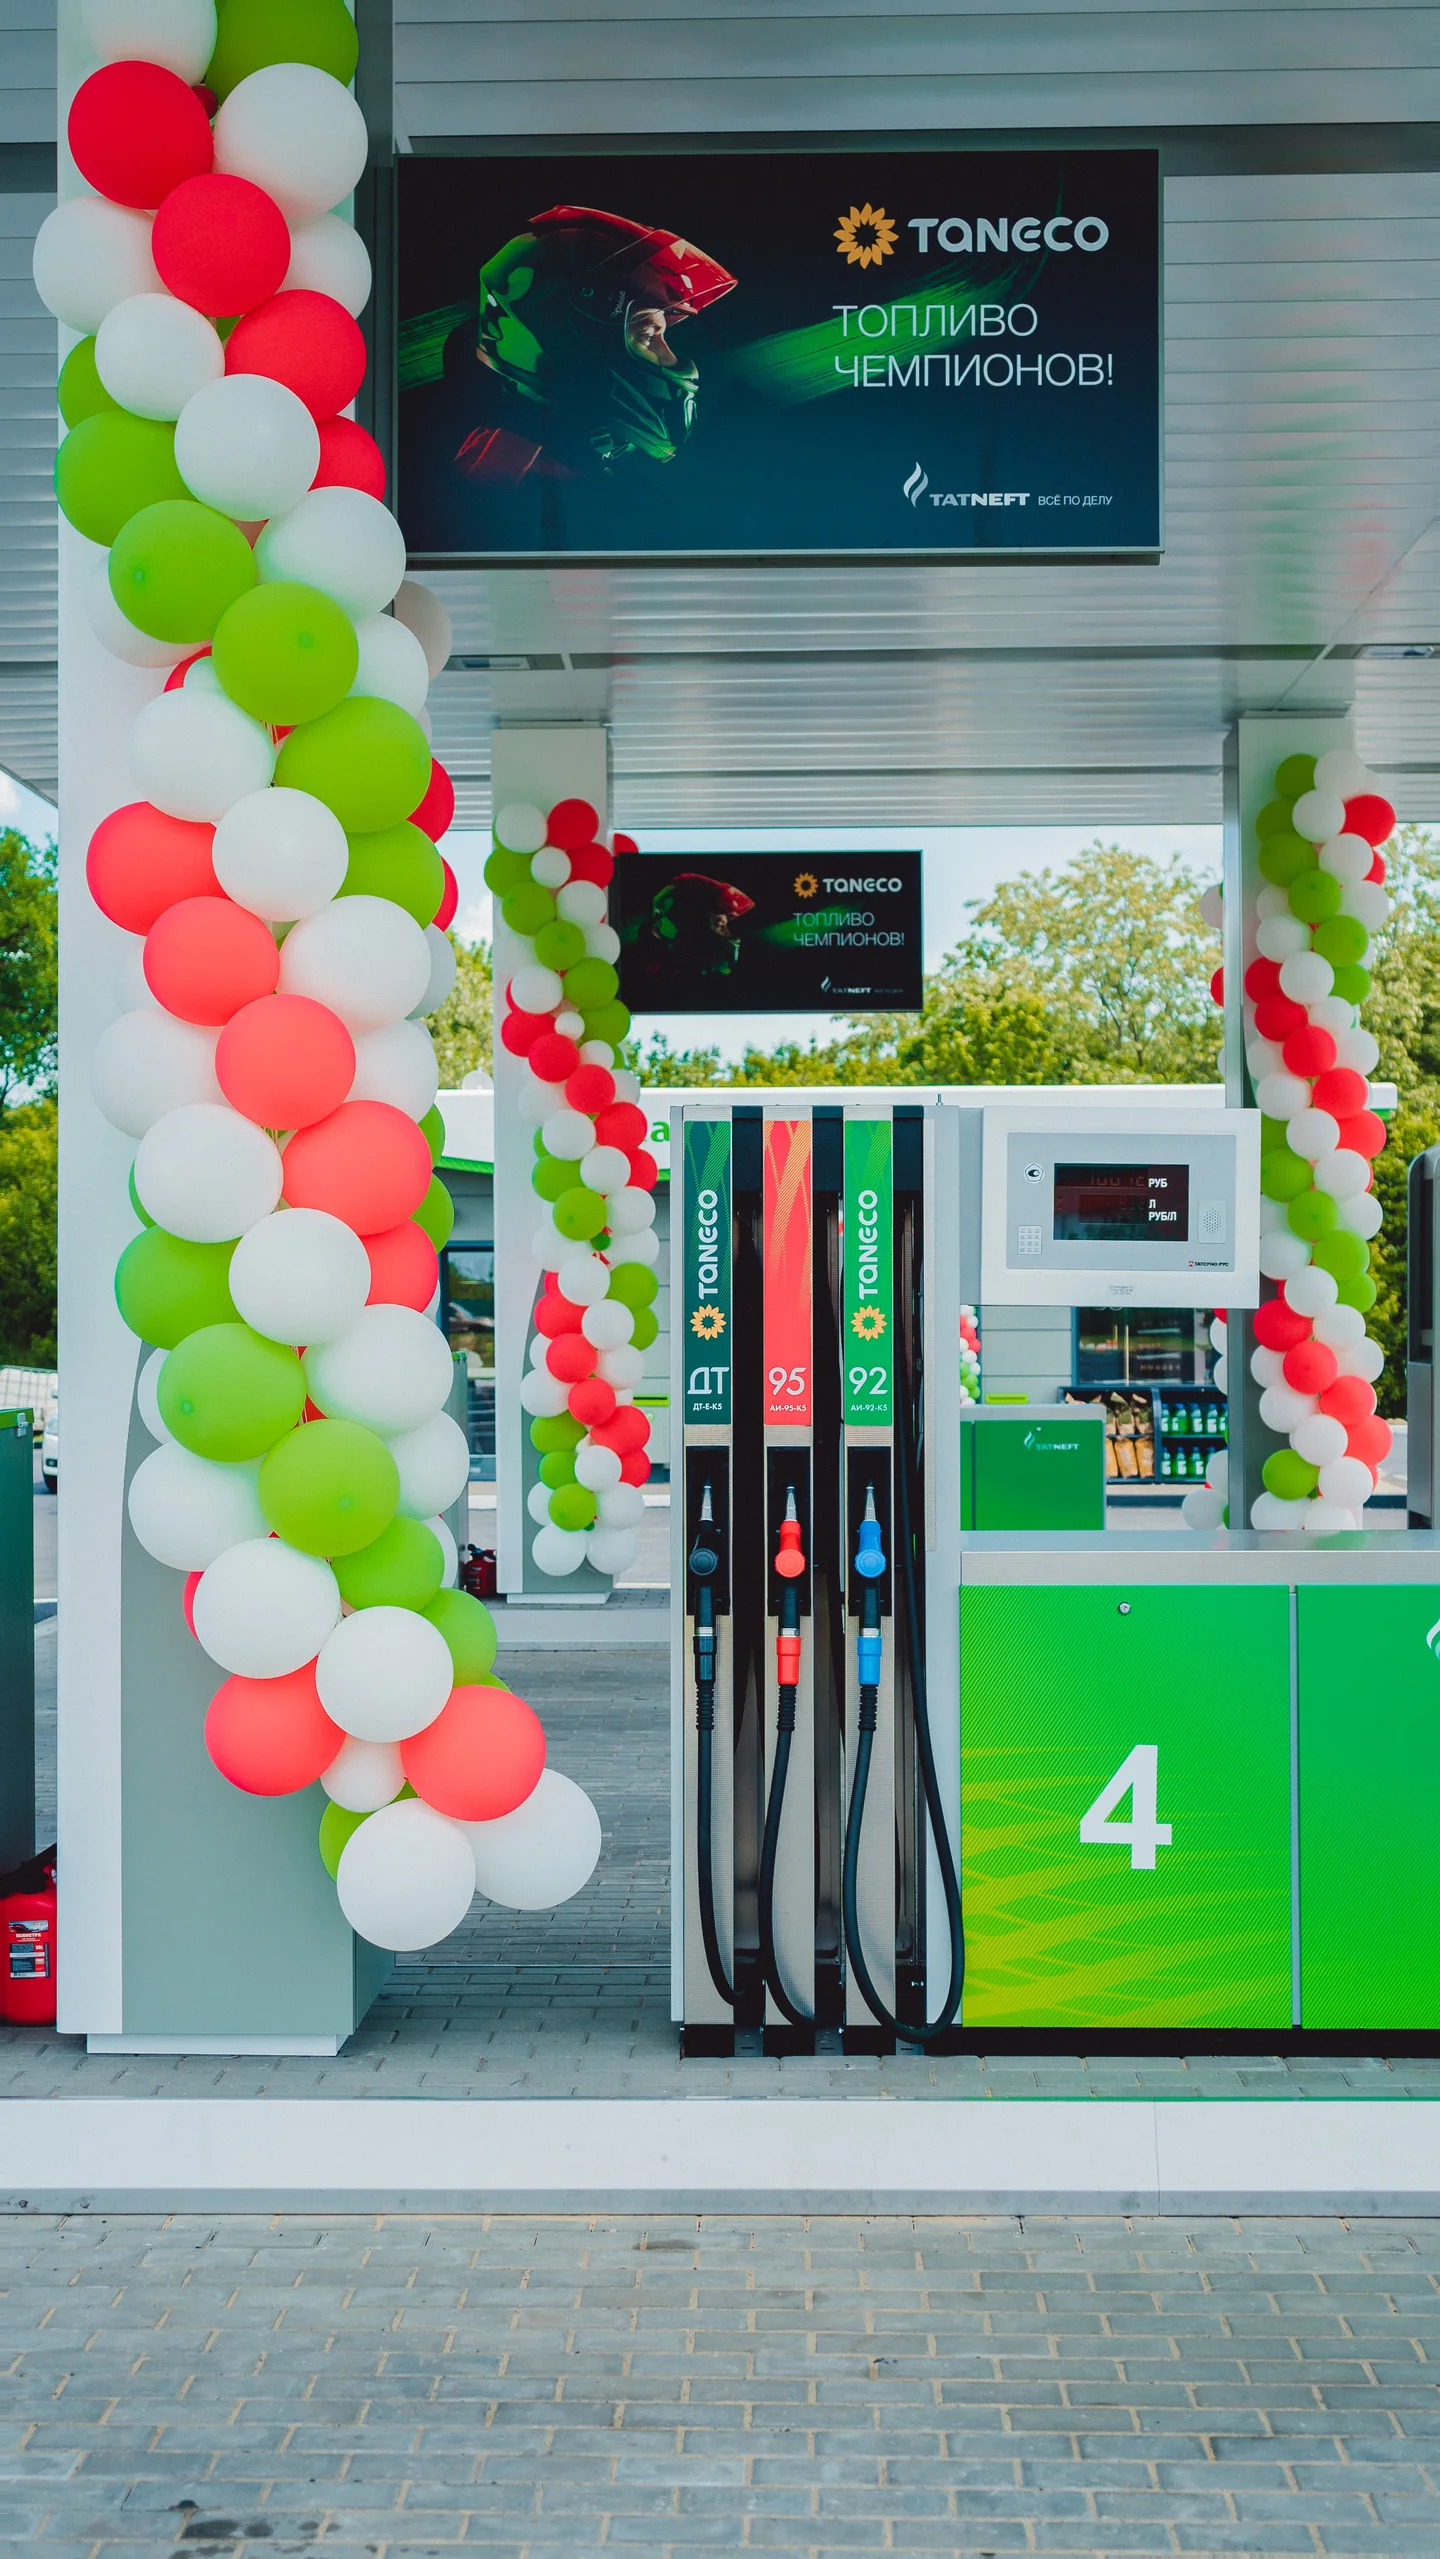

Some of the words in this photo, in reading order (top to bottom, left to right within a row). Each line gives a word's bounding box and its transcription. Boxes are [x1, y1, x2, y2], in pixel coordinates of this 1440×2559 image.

[832, 303, 1038, 337] ТОПЛИВО
[834, 353, 1114, 387] ЧЕМПИОНОВ!
[929, 493, 1030, 506] TATNEFT
[1038, 494, 1061, 506] ВСЁ
[1063, 496, 1080, 506] ПО
[1082, 495, 1113, 507] ДЕЛУ
[793, 912, 875, 927] ТОПЛИВО
[793, 932, 905, 946] ЧЕМПИОНОВ!
[1148, 1178, 1168, 1188] РУБ
[1148, 1199, 1157, 1209] Л
[1148, 1211, 1177, 1221] РУБ/Л
[687, 1366, 730, 1395] ДТ
[768, 1366, 807, 1396] 95
[848, 1366, 888, 1396] 92
[769, 1403, 807, 1413] АИ-95-К5
[850, 1403, 888, 1413] АИ-92-К5
[1079, 1744, 1173, 1870] 4
